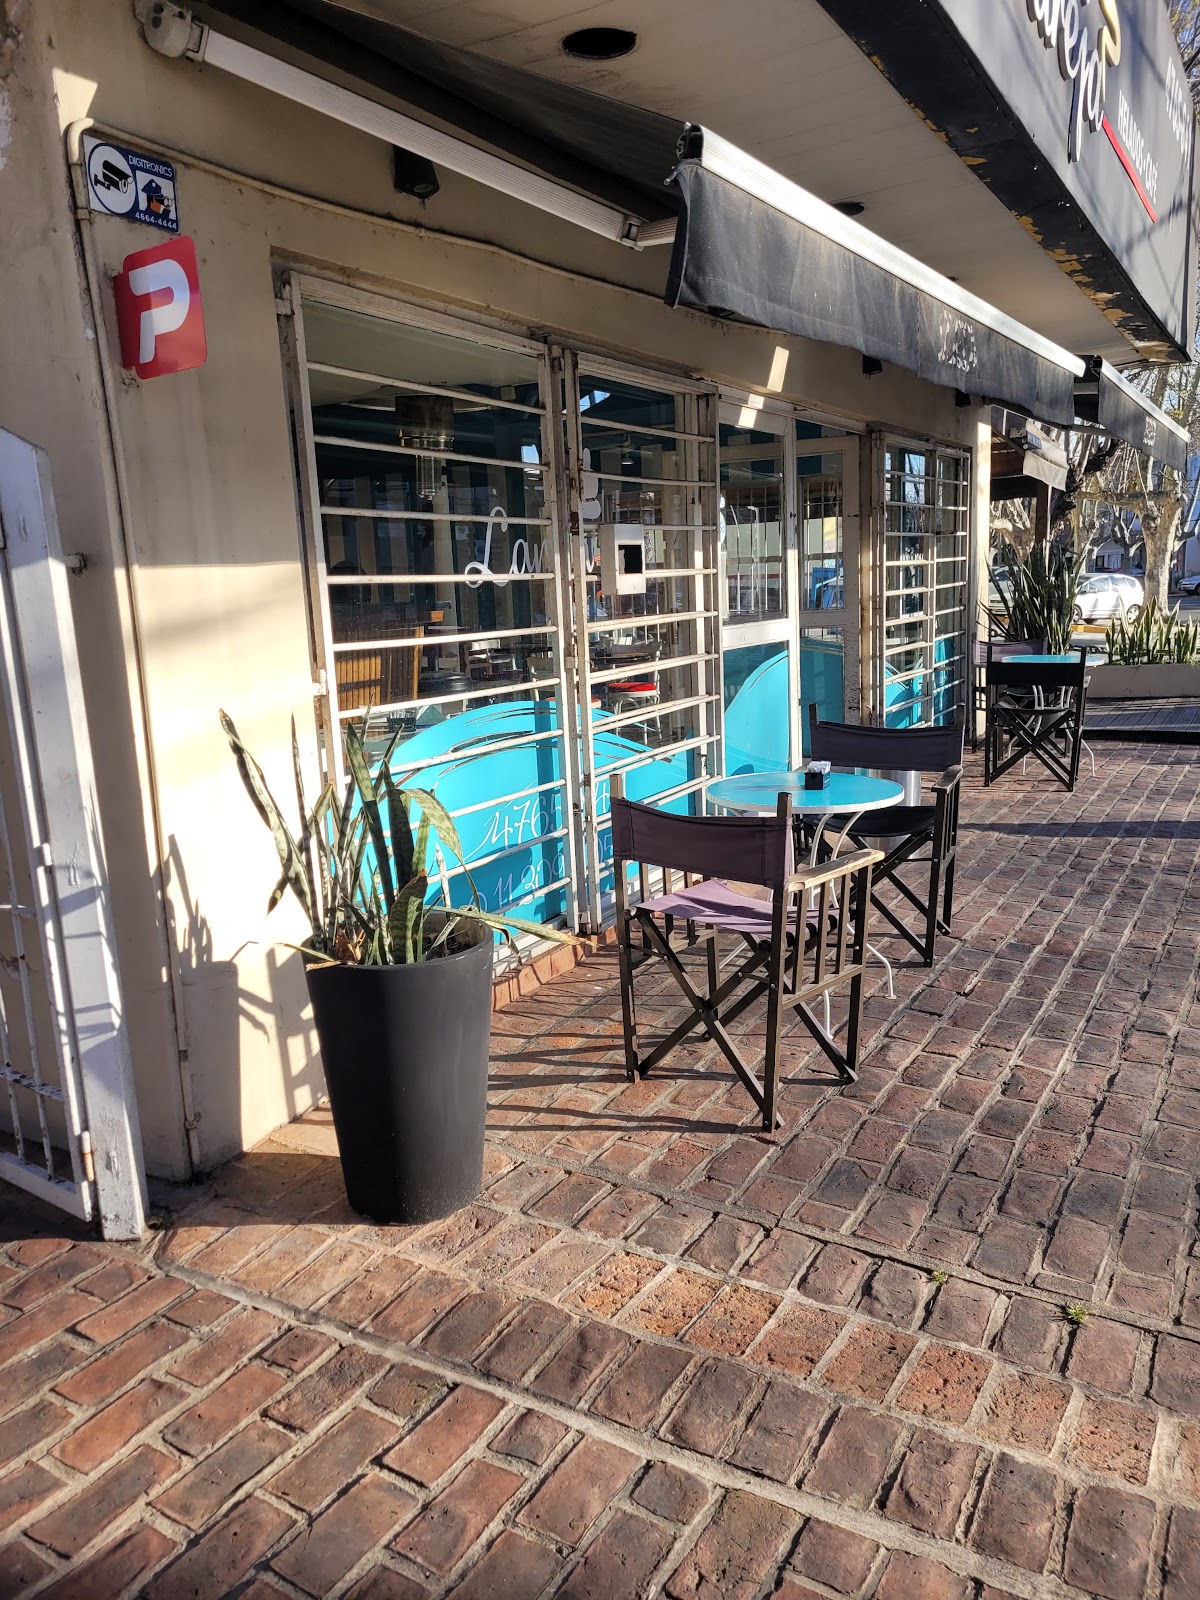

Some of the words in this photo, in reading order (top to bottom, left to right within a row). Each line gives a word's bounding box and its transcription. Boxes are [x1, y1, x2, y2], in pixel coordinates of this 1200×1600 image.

[1117, 89, 1145, 176] HELADOS
[128, 154, 173, 178] DIGITRONICS
[134, 211, 178, 230] 4664-4444
[128, 258, 191, 365] P
